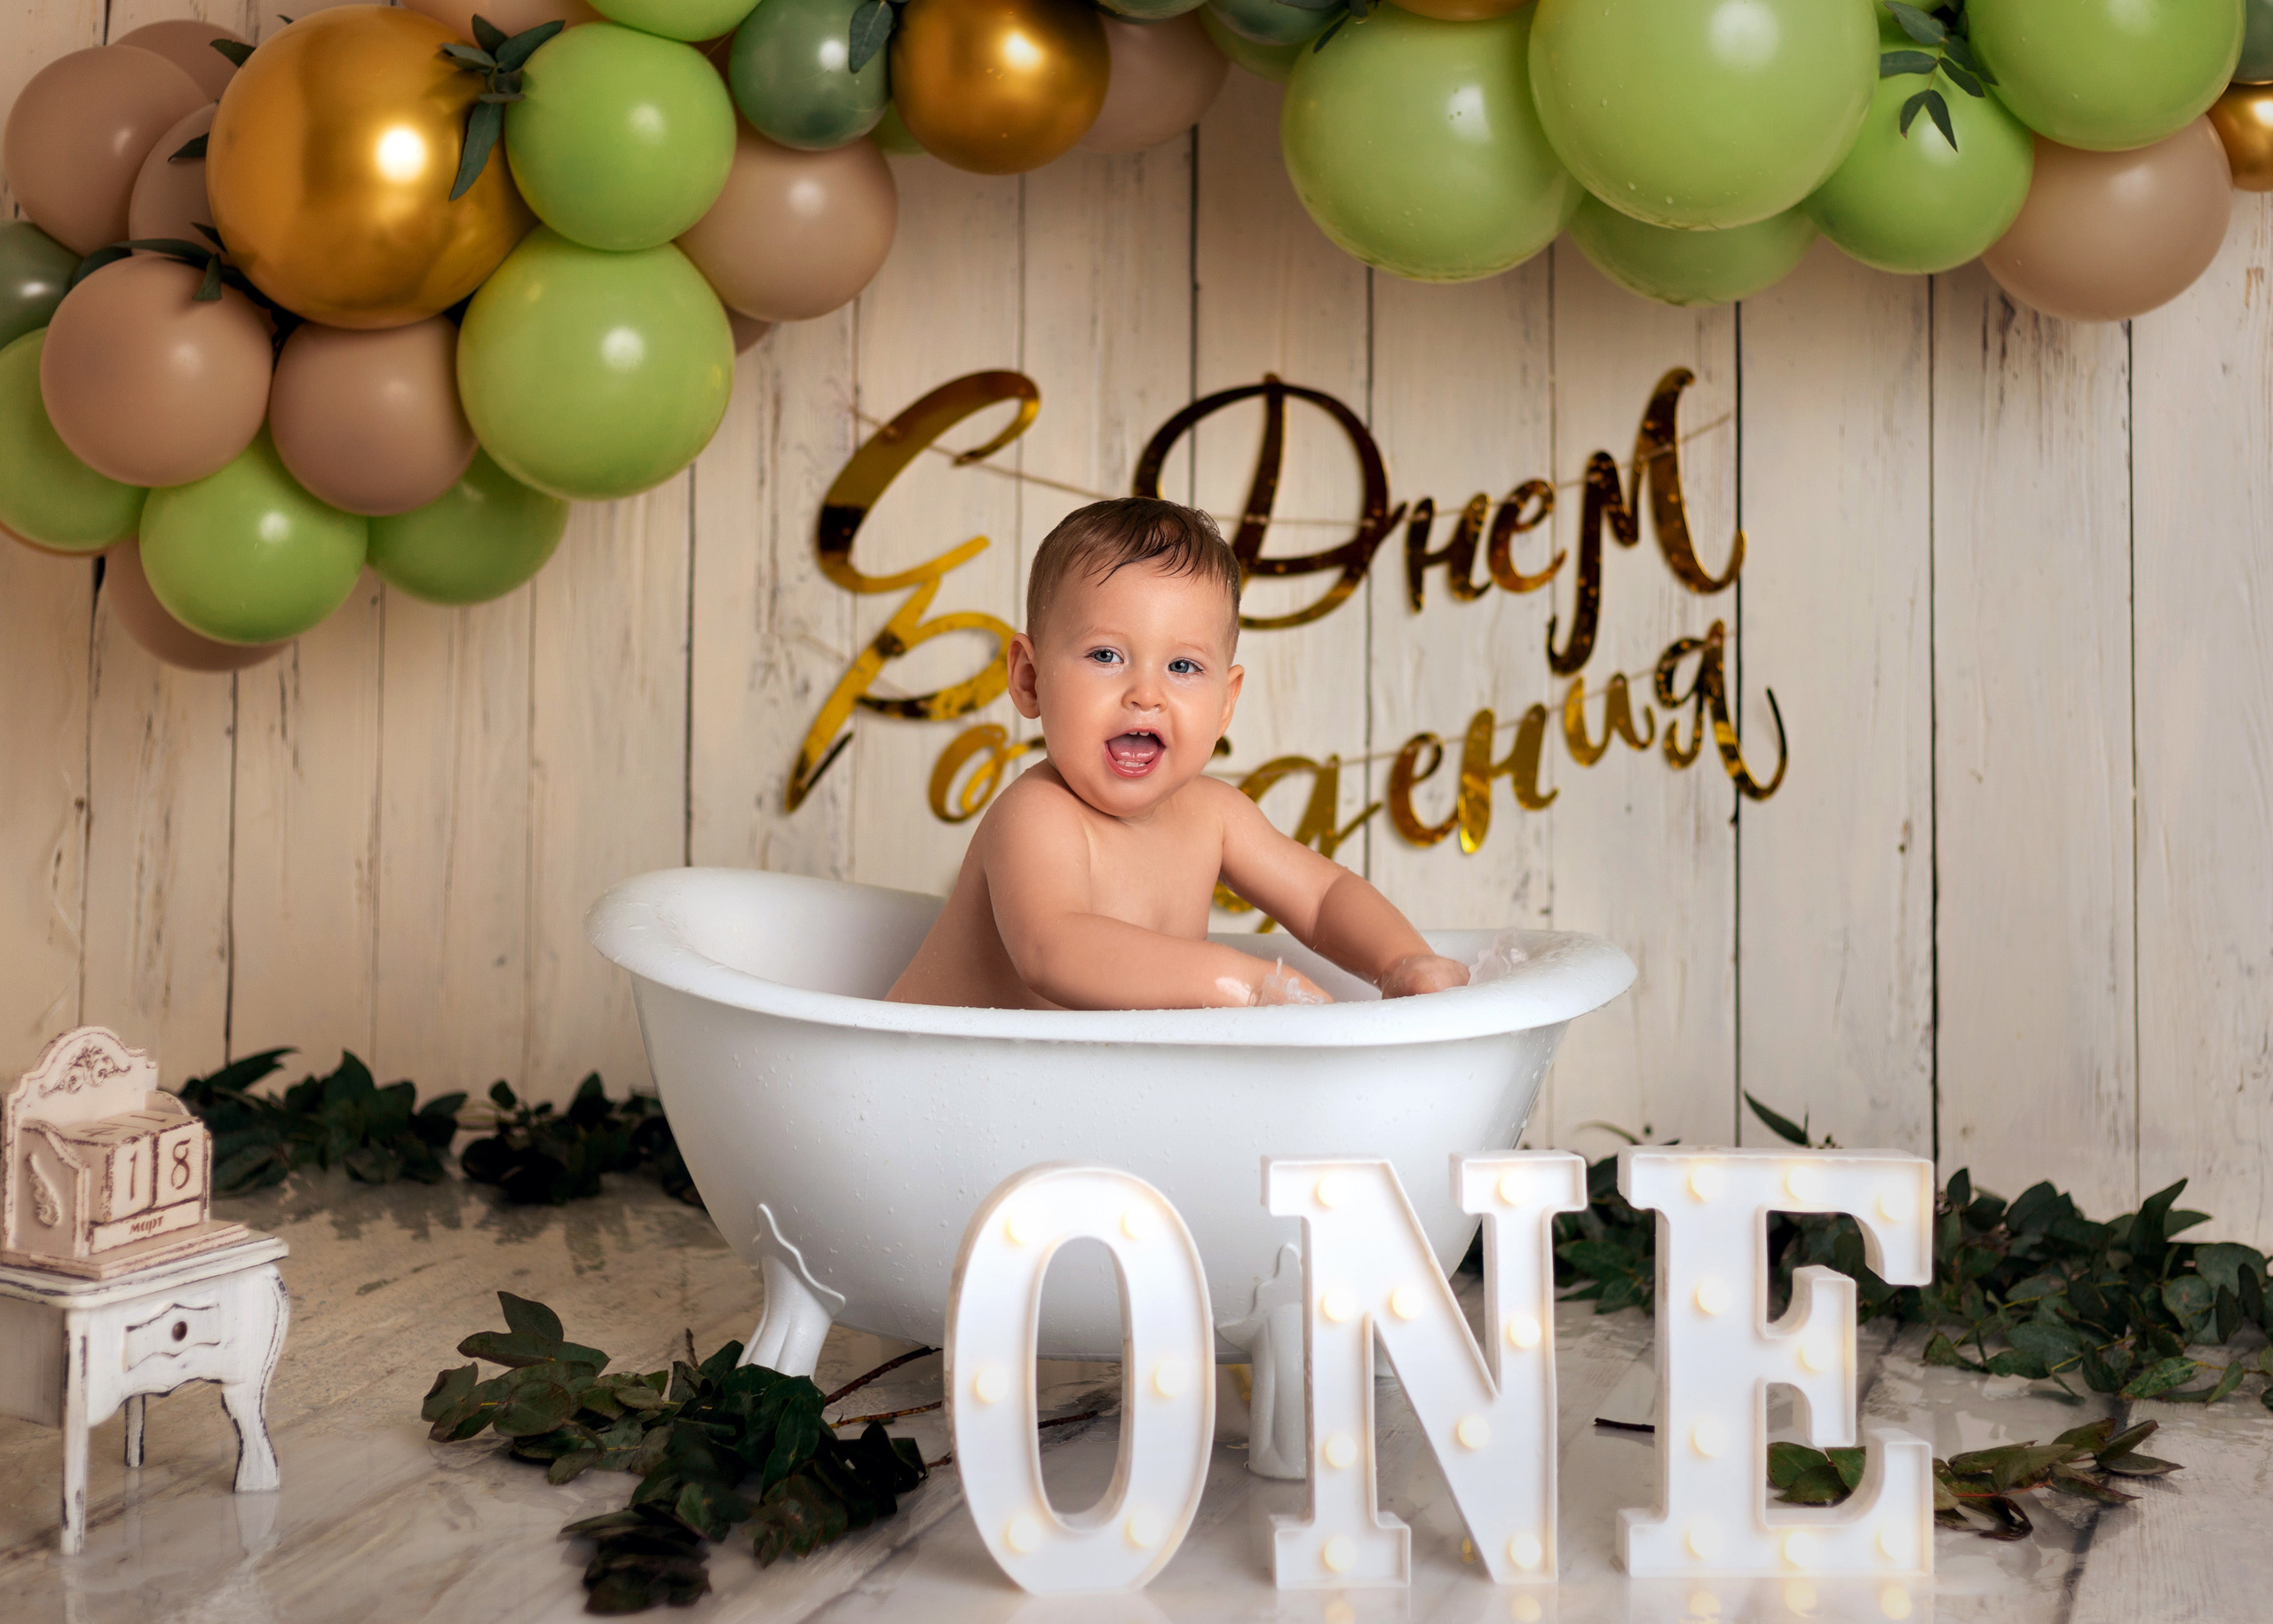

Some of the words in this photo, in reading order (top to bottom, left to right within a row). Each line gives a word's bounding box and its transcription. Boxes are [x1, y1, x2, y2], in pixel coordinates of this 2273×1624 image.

[815, 368, 1041, 595] С
[1132, 367, 1746, 677] Днем
[785, 575, 1788, 934] Родения
[944, 1149, 1935, 1596] ONE
